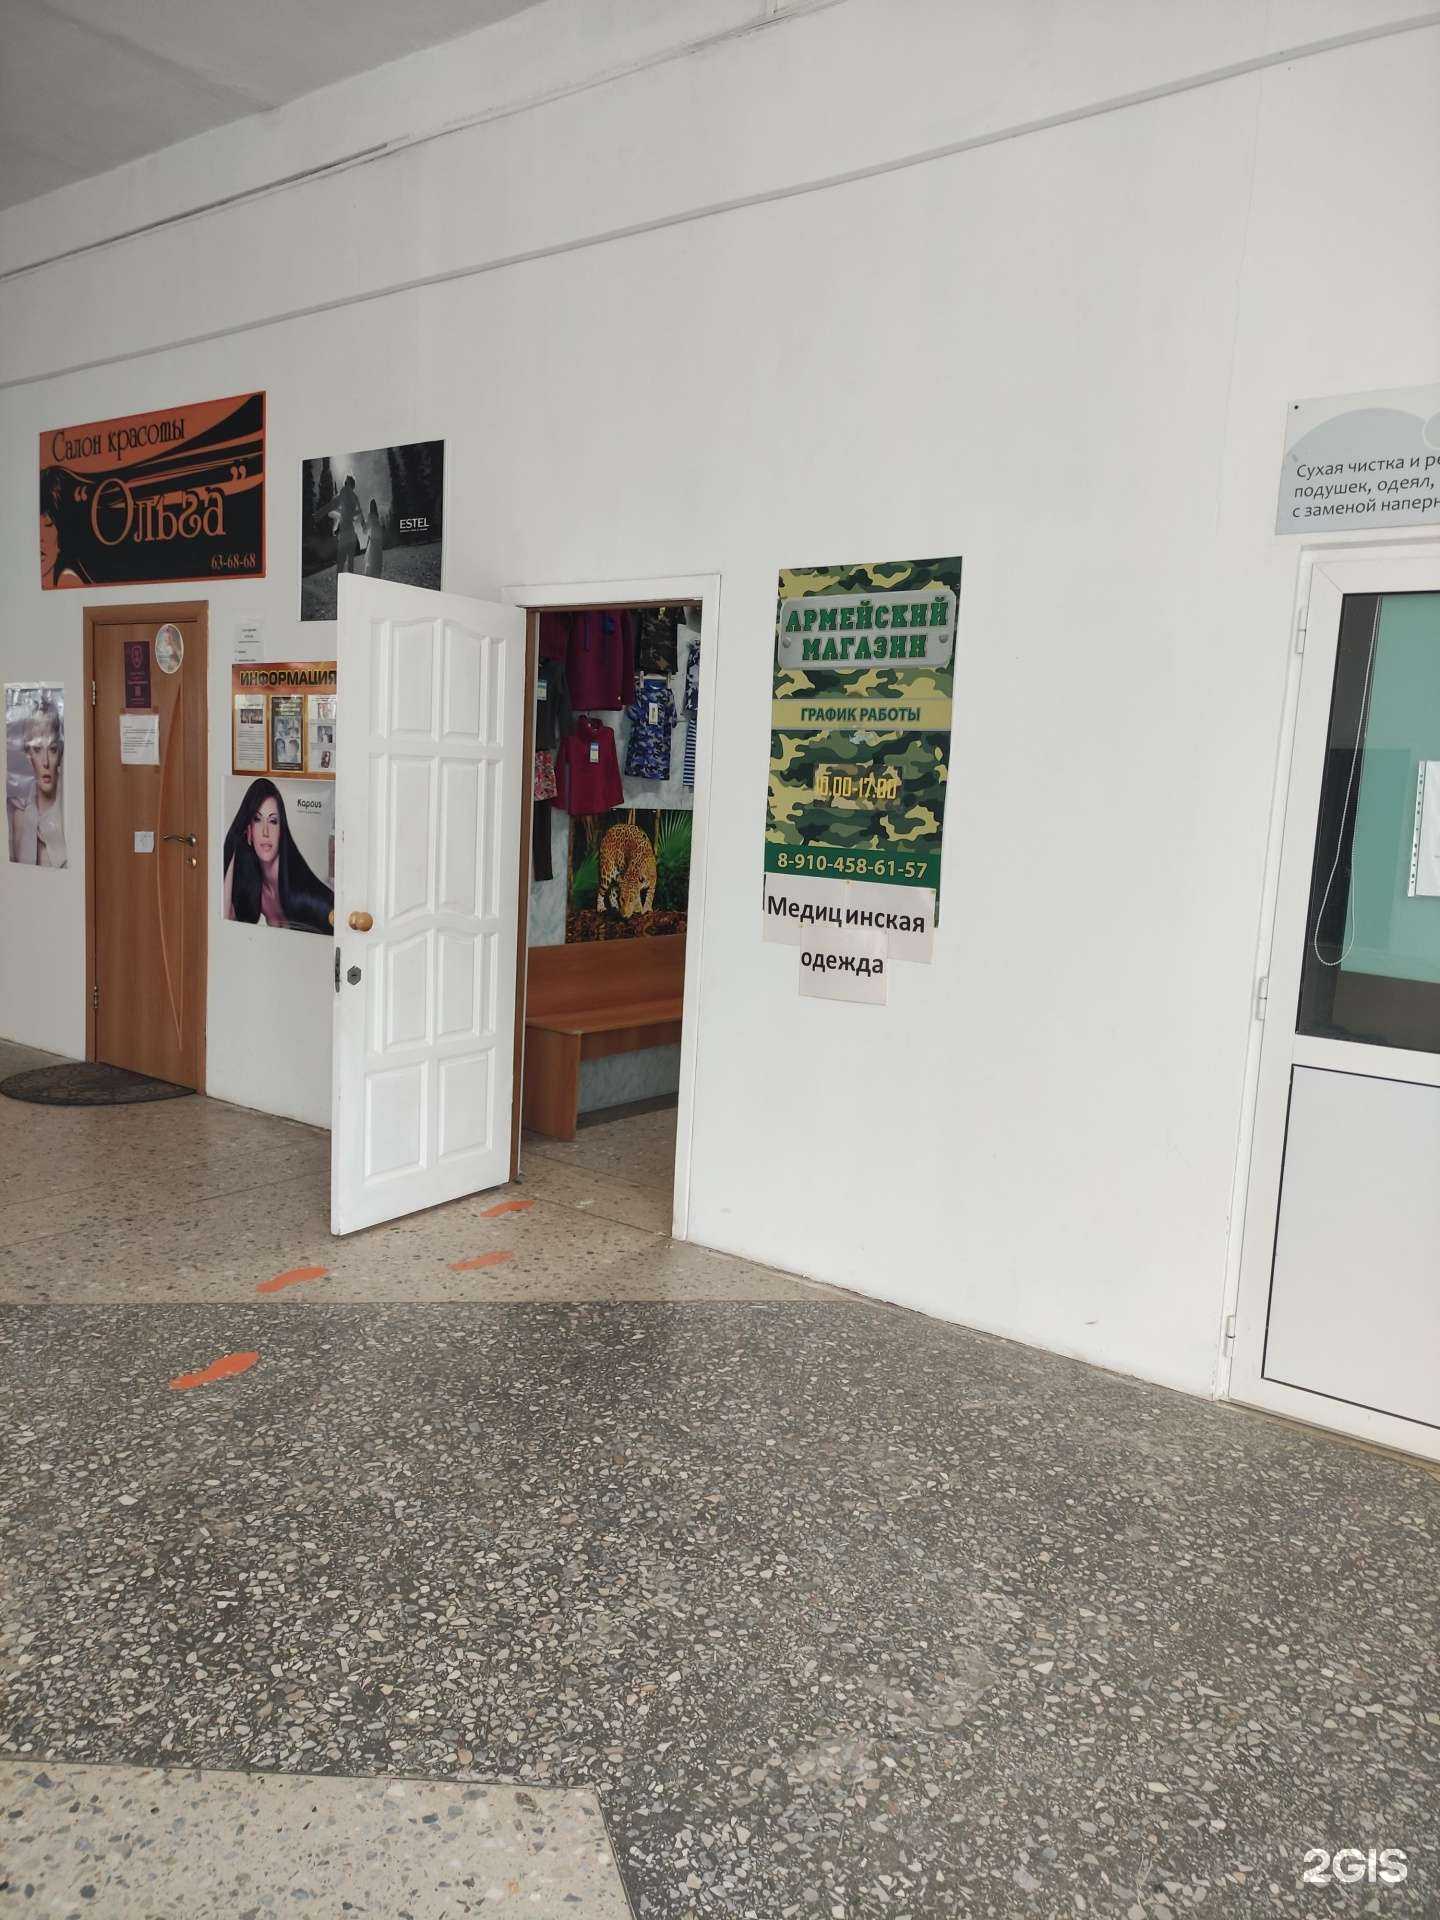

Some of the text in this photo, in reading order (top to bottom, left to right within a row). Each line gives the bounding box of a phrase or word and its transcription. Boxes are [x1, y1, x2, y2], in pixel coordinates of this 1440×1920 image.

[52, 418, 185, 463] Салон красоты
[1296, 463, 1344, 481] Сухая
[1348, 457, 1405, 474] чистка
[1410, 456, 1420, 468] и
[1294, 476, 1435, 500] подушек, одеял,
[1292, 506, 1301, 518] с
[1304, 498, 1376, 518] заменой
[399, 516, 431, 529] ESTEL
[211, 552, 256, 570] 63-68-68
[785, 595, 949, 633] АРМЕЙСКИЙ
[802, 634, 928, 661] МАГАЗИН
[240, 670, 337, 686] ИНФОРМАЦИЯ
[800, 707, 920, 721] ГРАФИК РАБОТЫ
[297, 798, 322, 809] Kapous
[777, 852, 928, 880] 8-910-458-61-57
[767, 895, 925, 933] Медицинская
[801, 951, 884, 977] одежда
